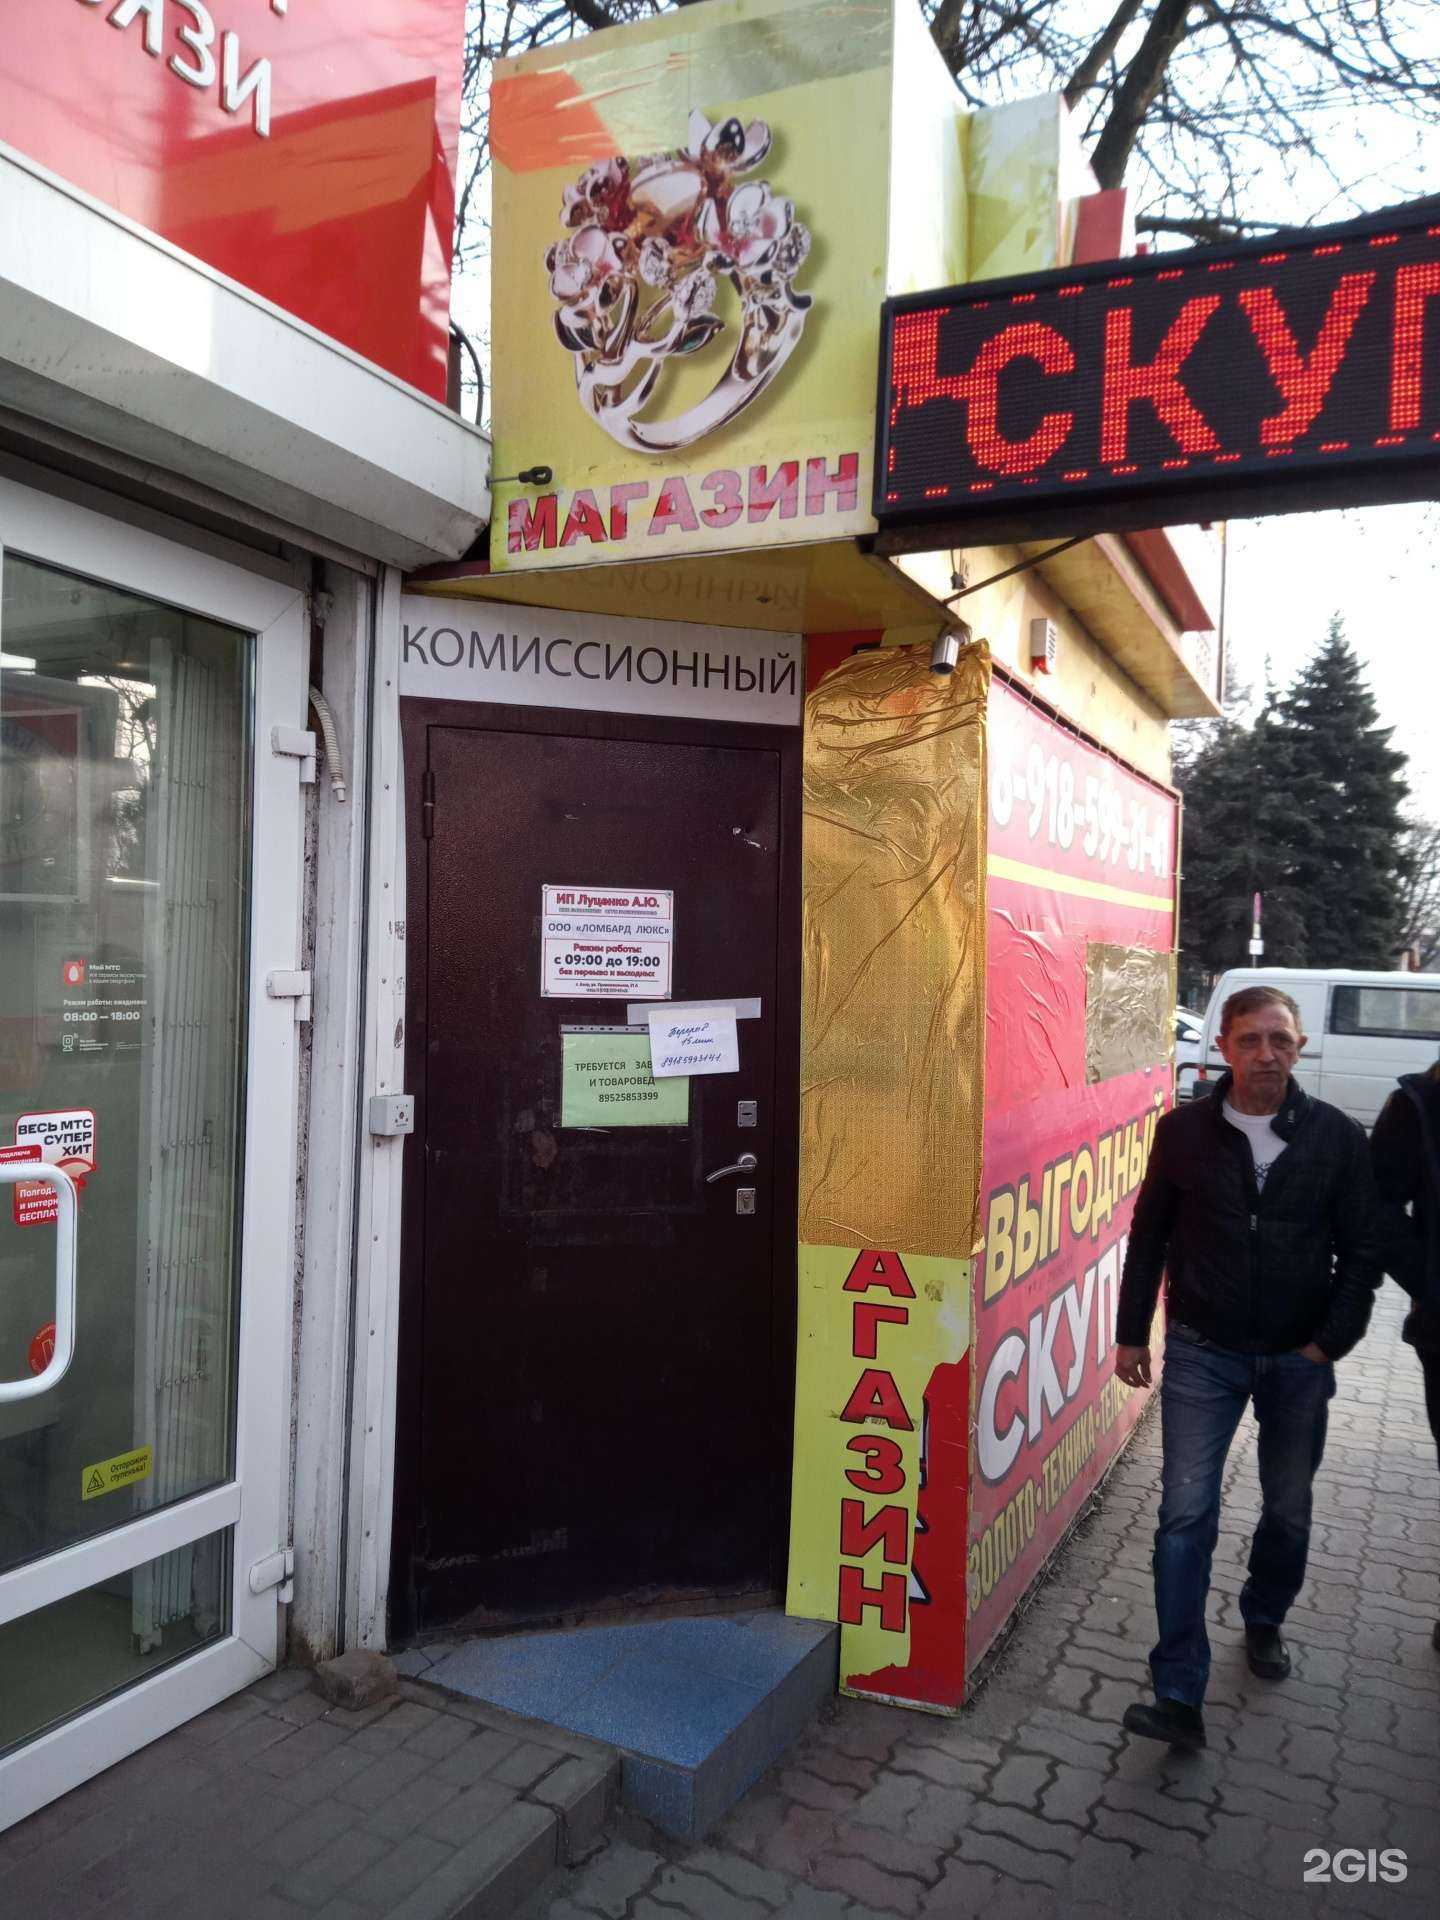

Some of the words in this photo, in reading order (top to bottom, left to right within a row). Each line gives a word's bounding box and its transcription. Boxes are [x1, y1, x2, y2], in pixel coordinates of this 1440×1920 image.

[507, 452, 860, 553] МАГАЗИН
[402, 624, 797, 696] КОМИССИОННЫЙ
[556, 893, 575, 905] ИП
[577, 894, 630, 908] Лущенко
[631, 896, 660, 908] А.Ю.
[548, 923, 571, 932] ООО
[576, 923, 632, 935] «ЛОМБАРД
[636, 924, 670, 935] ЛЮКС»
[554, 956, 562, 965] с
[565, 954, 603, 966] 09:00
[605, 957, 623, 967] до
[626, 955, 661, 967] 19:00
[63, 1012, 98, 1022] 08:00
[110, 1011, 140, 1021] 18:00
[575, 1061, 626, 1072] ТРЕБУЕТСЯ
[589, 1078, 596, 1087] И
[599, 1076, 656, 1087] ТОВАРОВЕД
[598, 1092, 659, 1103] 89525853399
[18, 1122, 58, 1136] ВЕСЬ
[60, 1118, 93, 1131] МТС
[44, 1131, 92, 1146] СУПЕР
[62, 1143, 92, 1157] ХИТ
[977, 1233, 1128, 1480] СКУП
[969, 1478, 1036, 1611] ЗОЛОТО
